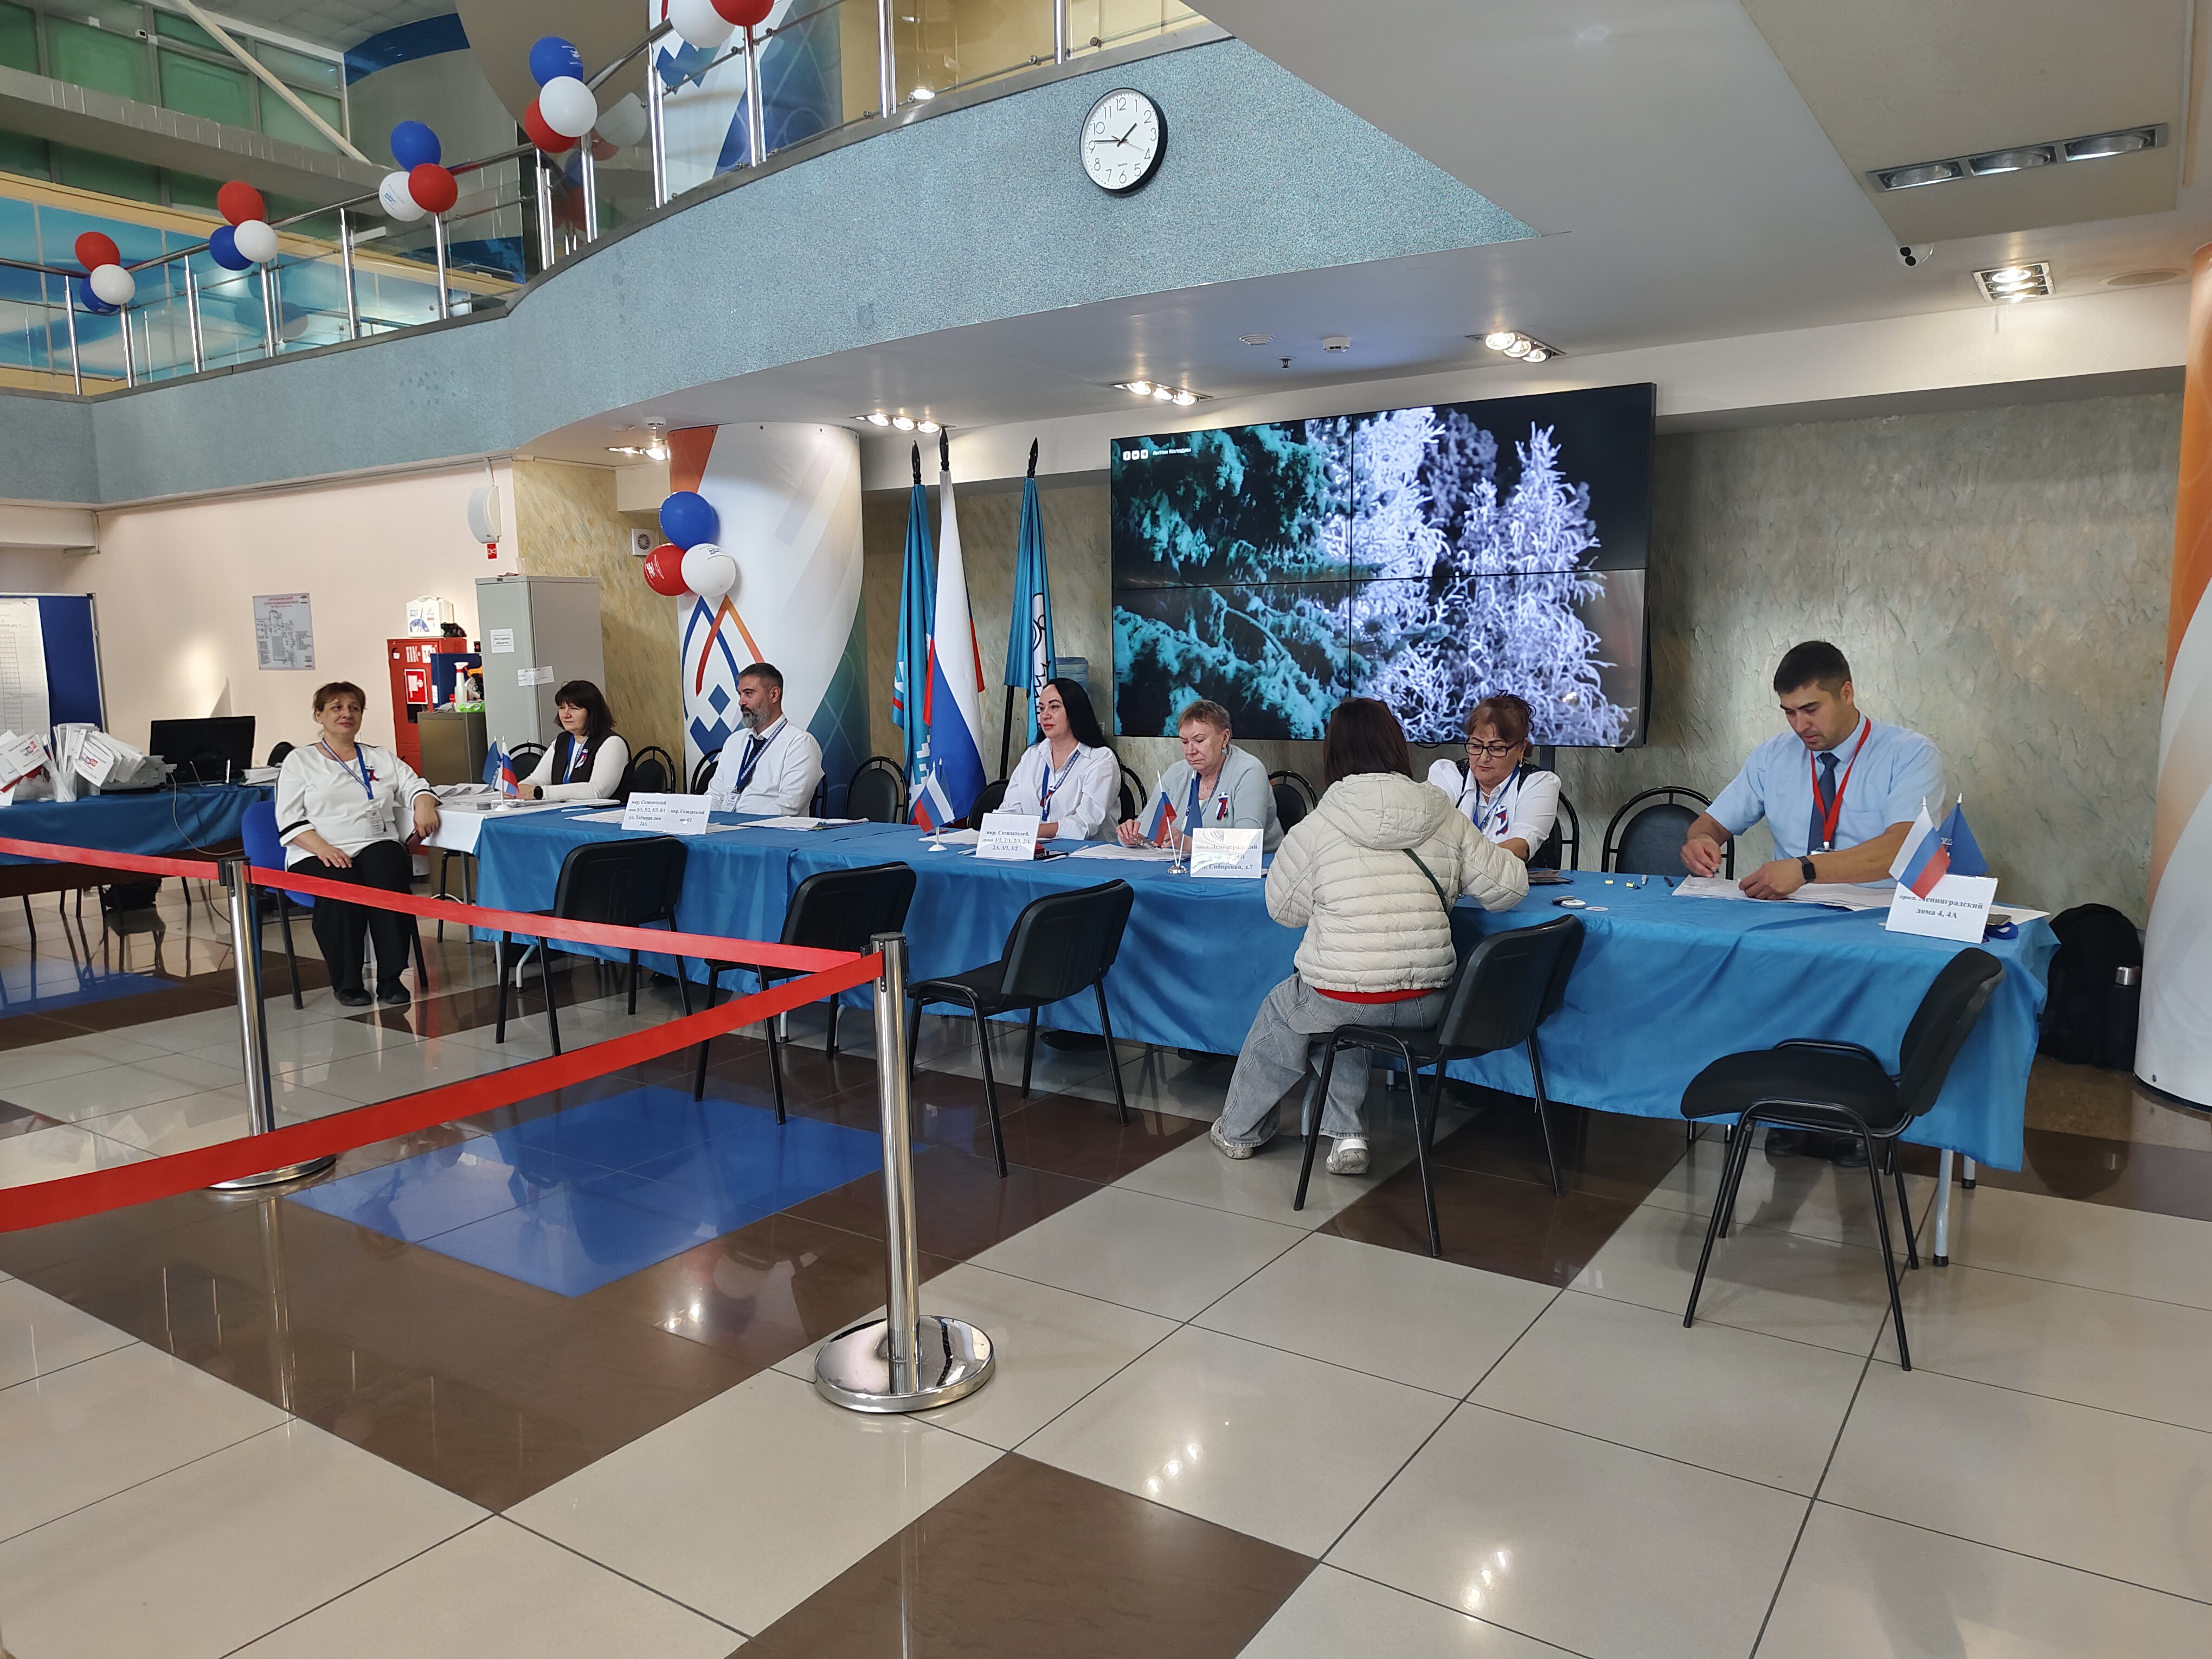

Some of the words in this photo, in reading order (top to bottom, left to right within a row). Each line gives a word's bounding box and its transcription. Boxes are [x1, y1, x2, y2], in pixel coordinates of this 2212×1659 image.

[1116, 97, 1127, 111] 12
[1135, 99, 1137, 112] 1
[1104, 106, 1111, 120] 11
[1144, 110, 1152, 124] 2
[1093, 121, 1105, 136] 10
[1150, 127, 1157, 141] 3
[1088, 140, 1096, 154] 9
[1144, 147, 1151, 160] 4
[1094, 157, 1101, 171] 8
[1134, 163, 1141, 177] 5
[1105, 169, 1112, 182] 7
[1119, 170, 1127, 184] 6
[1919, 897, 1983, 910] енинградский
